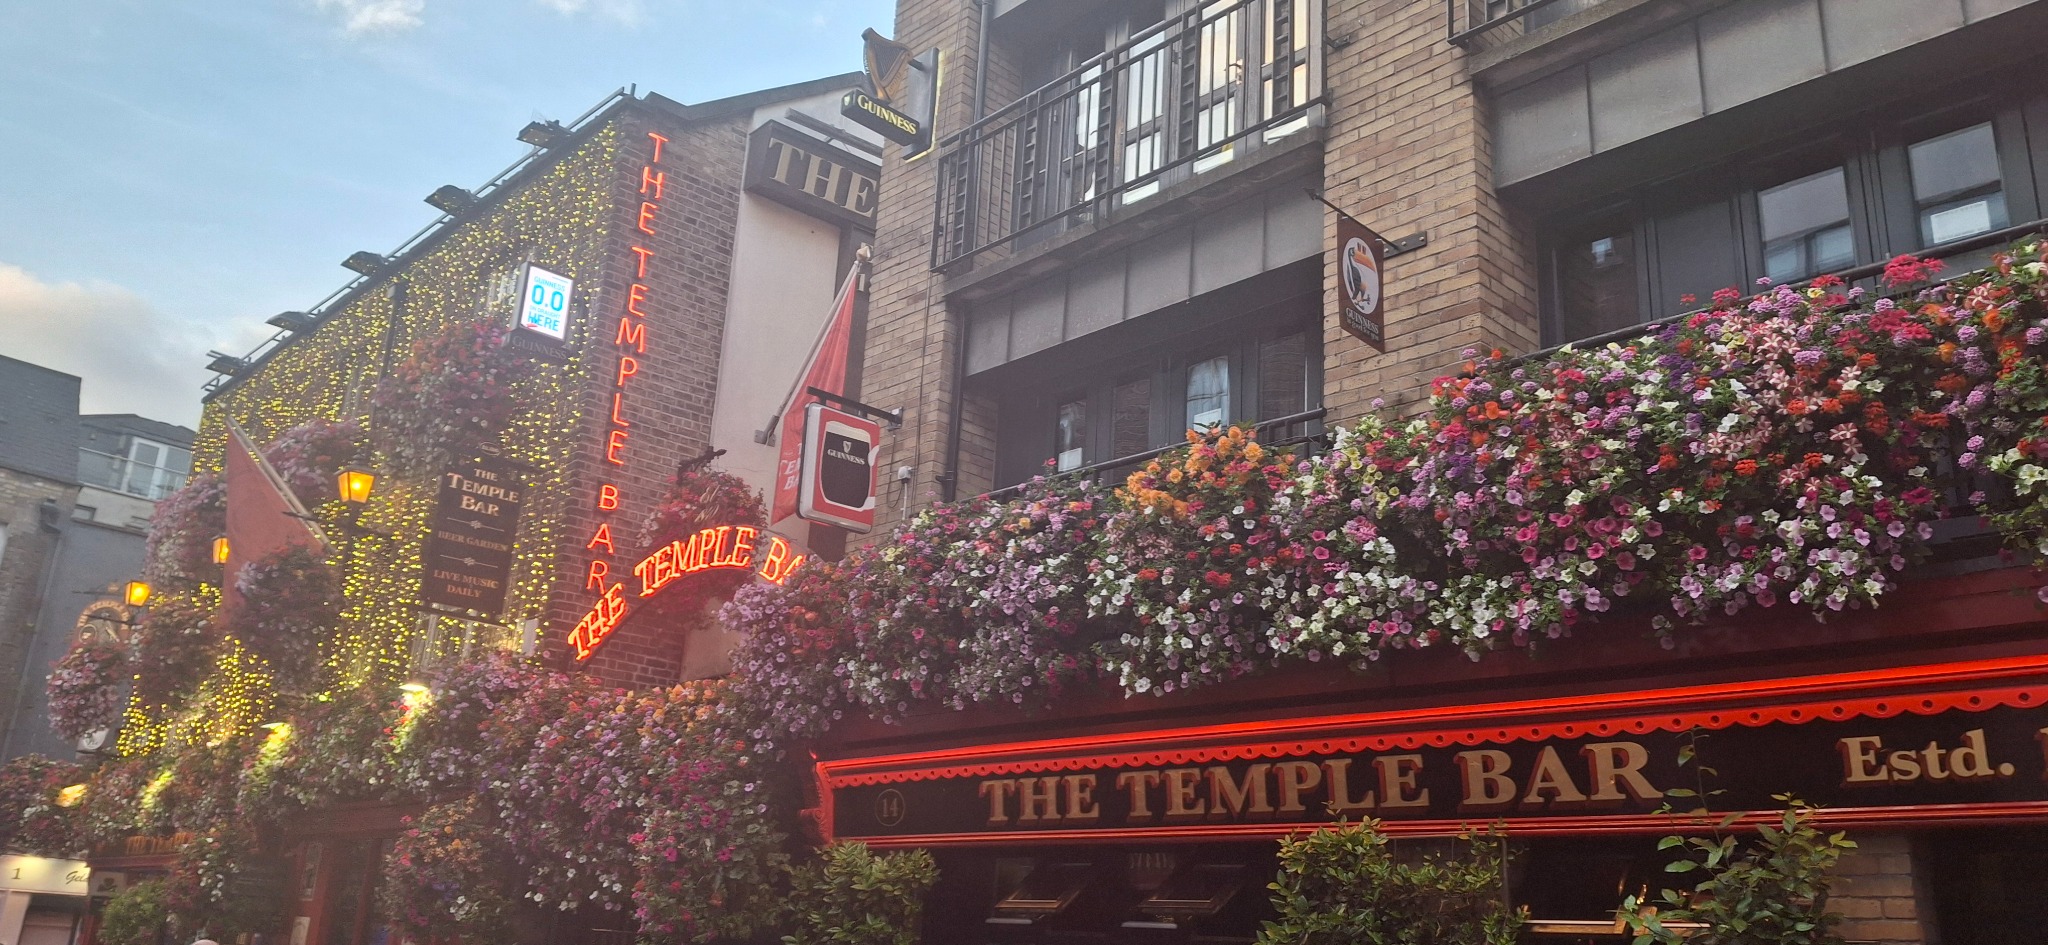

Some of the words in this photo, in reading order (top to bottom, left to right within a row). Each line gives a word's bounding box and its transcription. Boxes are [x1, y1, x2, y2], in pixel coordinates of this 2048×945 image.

[857, 94, 917, 135] GUINNESS
[640, 131, 669, 235] THE
[768, 137, 878, 218] THE
[534, 276, 566, 292] GUINNESS
[531, 284, 564, 311] 0.0
[527, 311, 560, 332] HERE
[1345, 308, 1379, 334] GUINNESS
[512, 335, 567, 359] GUINNESS
[614, 245, 655, 465] TEMPLE
[827, 448, 865, 465] GUINNESS
[447, 472, 519, 503] TEMPLE
[473, 468, 498, 482] THE
[460, 494, 500, 517] BAR
[438, 530, 465, 544] BEER
[466, 536, 509, 552] GARDEN
[586, 483, 619, 595] BAR
[433, 569, 460, 582] LIVE
[462, 575, 499, 589] MUSIC
[447, 584, 482, 598] DAILY
[567, 582, 628, 661] THE
[633, 525, 756, 597] TEMPLE
[979, 773, 1099, 824] THE
[1117, 753, 1430, 818] TEMPLE
[1454, 741, 1664, 806] BAR
[1839, 728, 2015, 783] Estd.
[882, 798, 900, 817] 14
